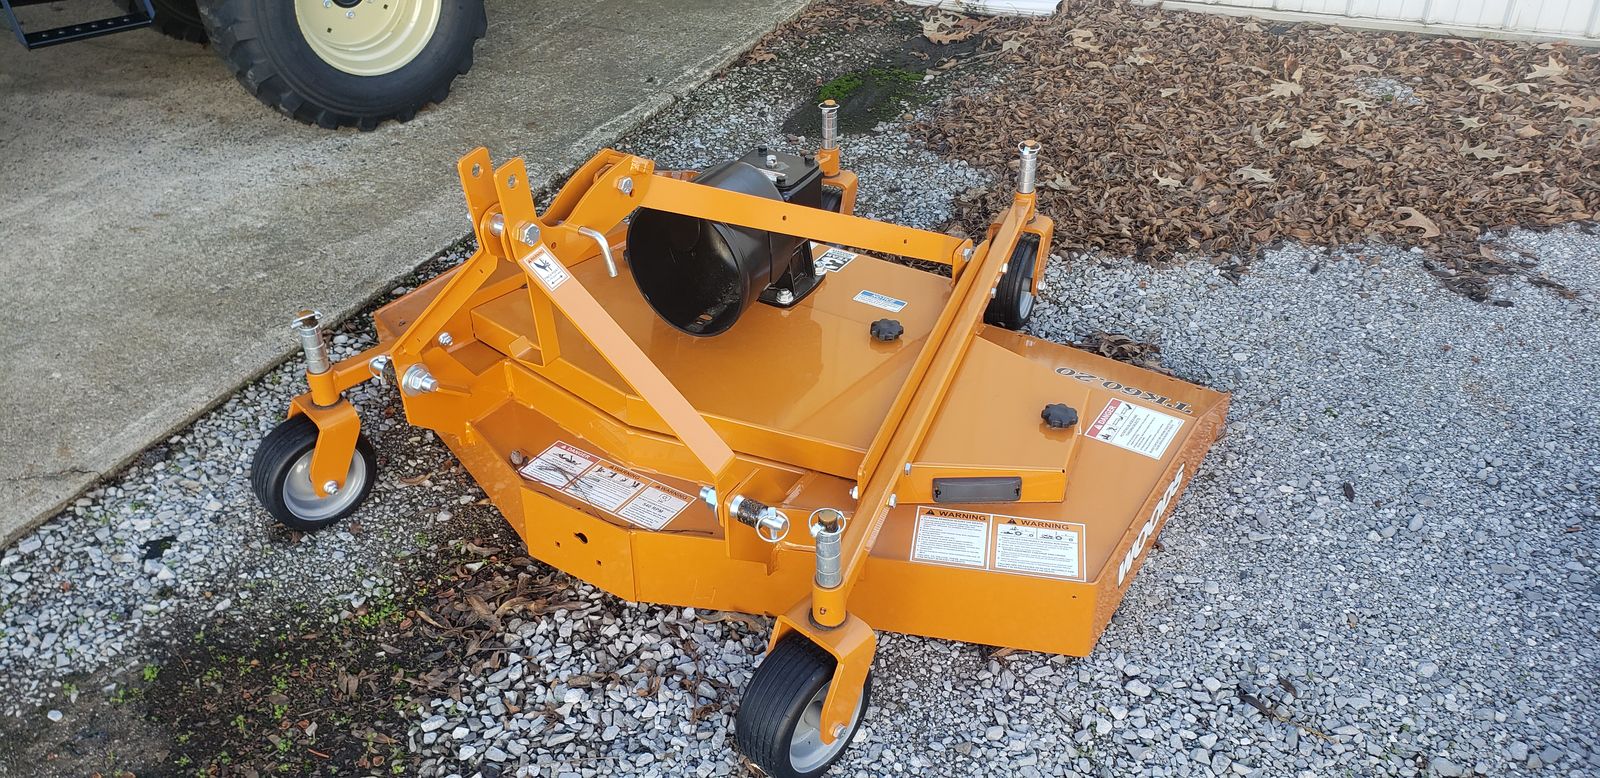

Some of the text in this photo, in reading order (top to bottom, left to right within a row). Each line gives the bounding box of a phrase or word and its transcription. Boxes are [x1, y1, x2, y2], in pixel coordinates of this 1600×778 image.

[1055, 367, 1193, 414] TK60.20
[1099, 405, 1117, 430] DANGER
[567, 446, 591, 460] DANGER
[661, 486, 688, 500] WARNING
[939, 510, 986, 521] WARNING
[1021, 519, 1069, 530] WARNING
[1118, 462, 1185, 587] WOODS
